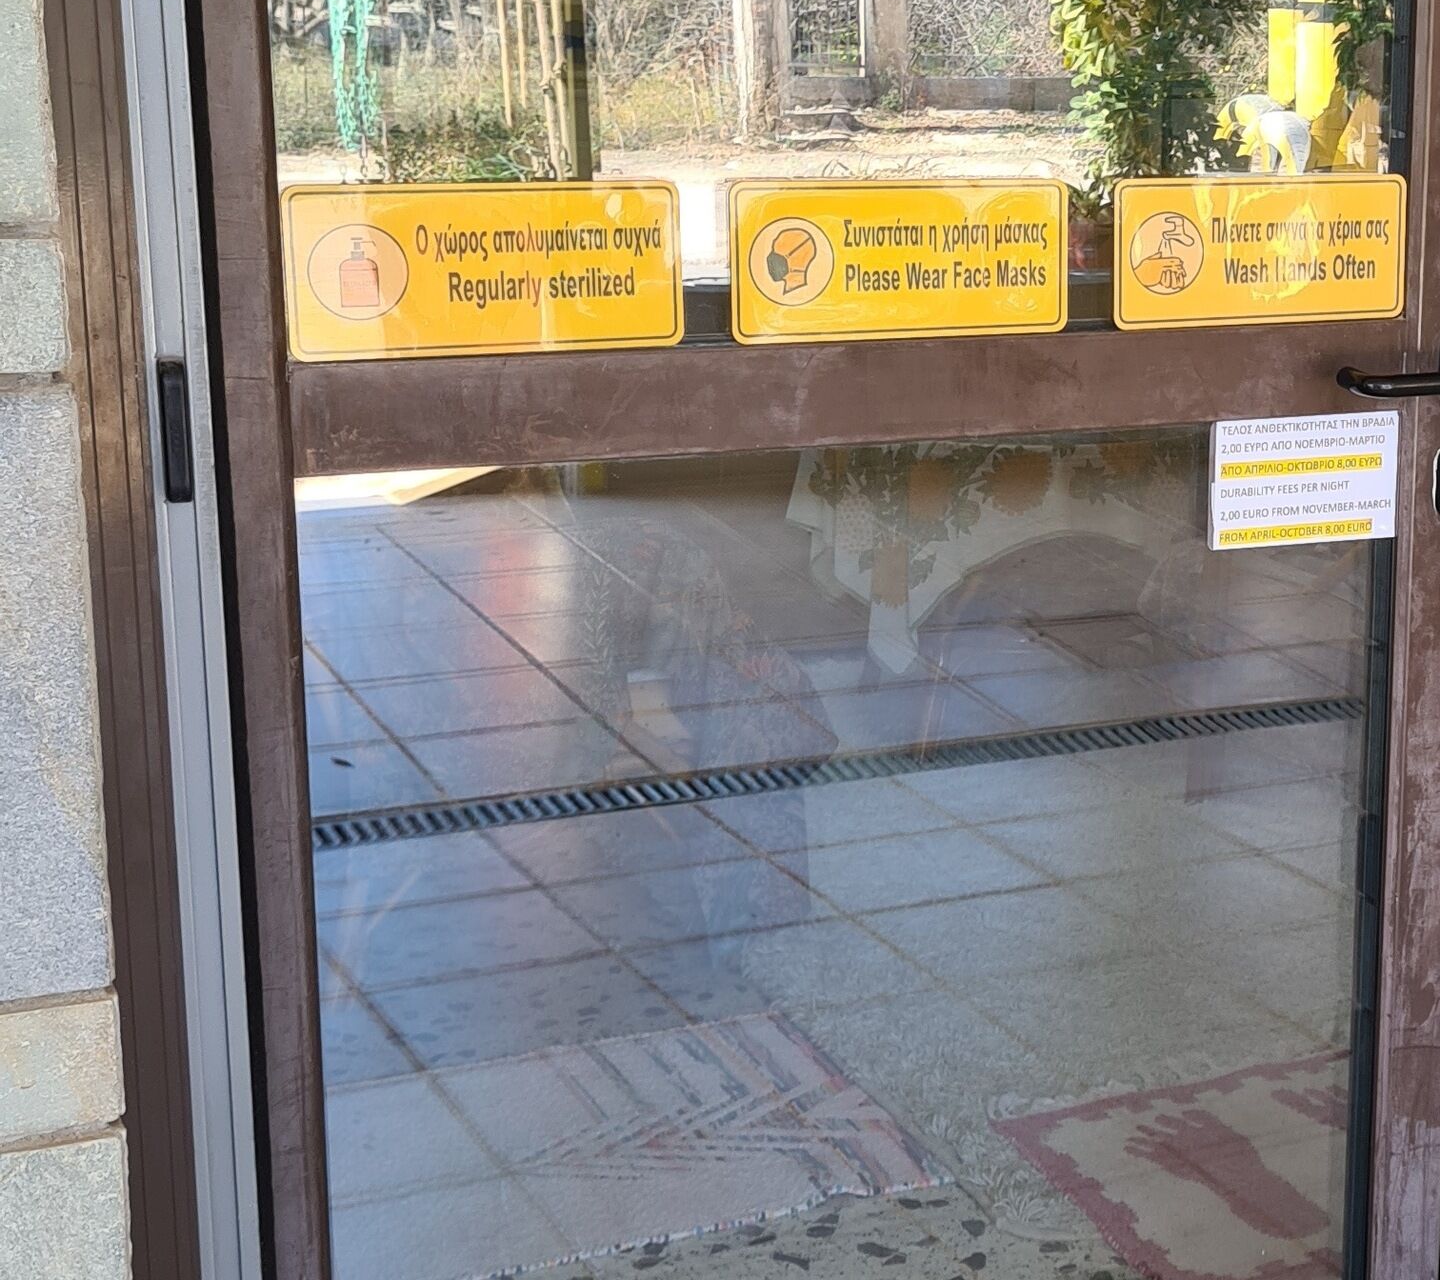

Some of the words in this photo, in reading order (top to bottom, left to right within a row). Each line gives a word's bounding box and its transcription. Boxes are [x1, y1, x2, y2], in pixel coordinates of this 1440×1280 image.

[434, 223, 488, 262] χώρος
[493, 222, 608, 260] απολυμαίνεται
[613, 219, 662, 257] συχνά
[844, 218, 923, 248] Συνιστάται
[929, 223, 938, 252] η
[943, 217, 990, 253] χρήση
[994, 216, 1048, 249] μάσκας
[1212, 216, 1261, 243] Πλένετε
[1328, 214, 1361, 247] χέρια
[1366, 219, 1389, 244] σας
[846, 264, 900, 291] Please
[905, 264, 948, 289] Wear
[953, 262, 991, 288] Face
[996, 260, 1046, 286] Masks
[1224, 257, 1268, 284] Wash
[1333, 254, 1376, 280] Often
[449, 271, 541, 308] Regularly
[549, 267, 635, 299] sterilized
[1222, 424, 1253, 436] ΤΕΛΟΣ
[1340, 418, 1360, 429] ΤΗΝ
[1221, 443, 1242, 455] 2,00
[1244, 442, 1268, 452] ΕΥΡΩ
[1270, 440, 1292, 451] ΑΠΟ
[1221, 466, 1242, 477] ΑΠΟ
[1337, 458, 1357, 469] 8,00
[1358, 456, 1382, 467] ΕΥΡΩ
[1220, 486, 1275, 499] DURABILITY
[1277, 483, 1299, 494] FEES
[1301, 482, 1318, 493] PER
[1320, 480, 1350, 491] NIGHT
[1220, 510, 1241, 522] 2,00
[1242, 508, 1269, 519] EURO
[1272, 506, 1300, 517] FROM
[1302, 499, 1391, 514] NOVEMBER-MARCH
[1219, 531, 1248, 543] FROM
[1250, 526, 1323, 540] APRIL-OCTOBER
[1326, 524, 1346, 535] 8,00
[1347, 522, 1372, 532] EURO
